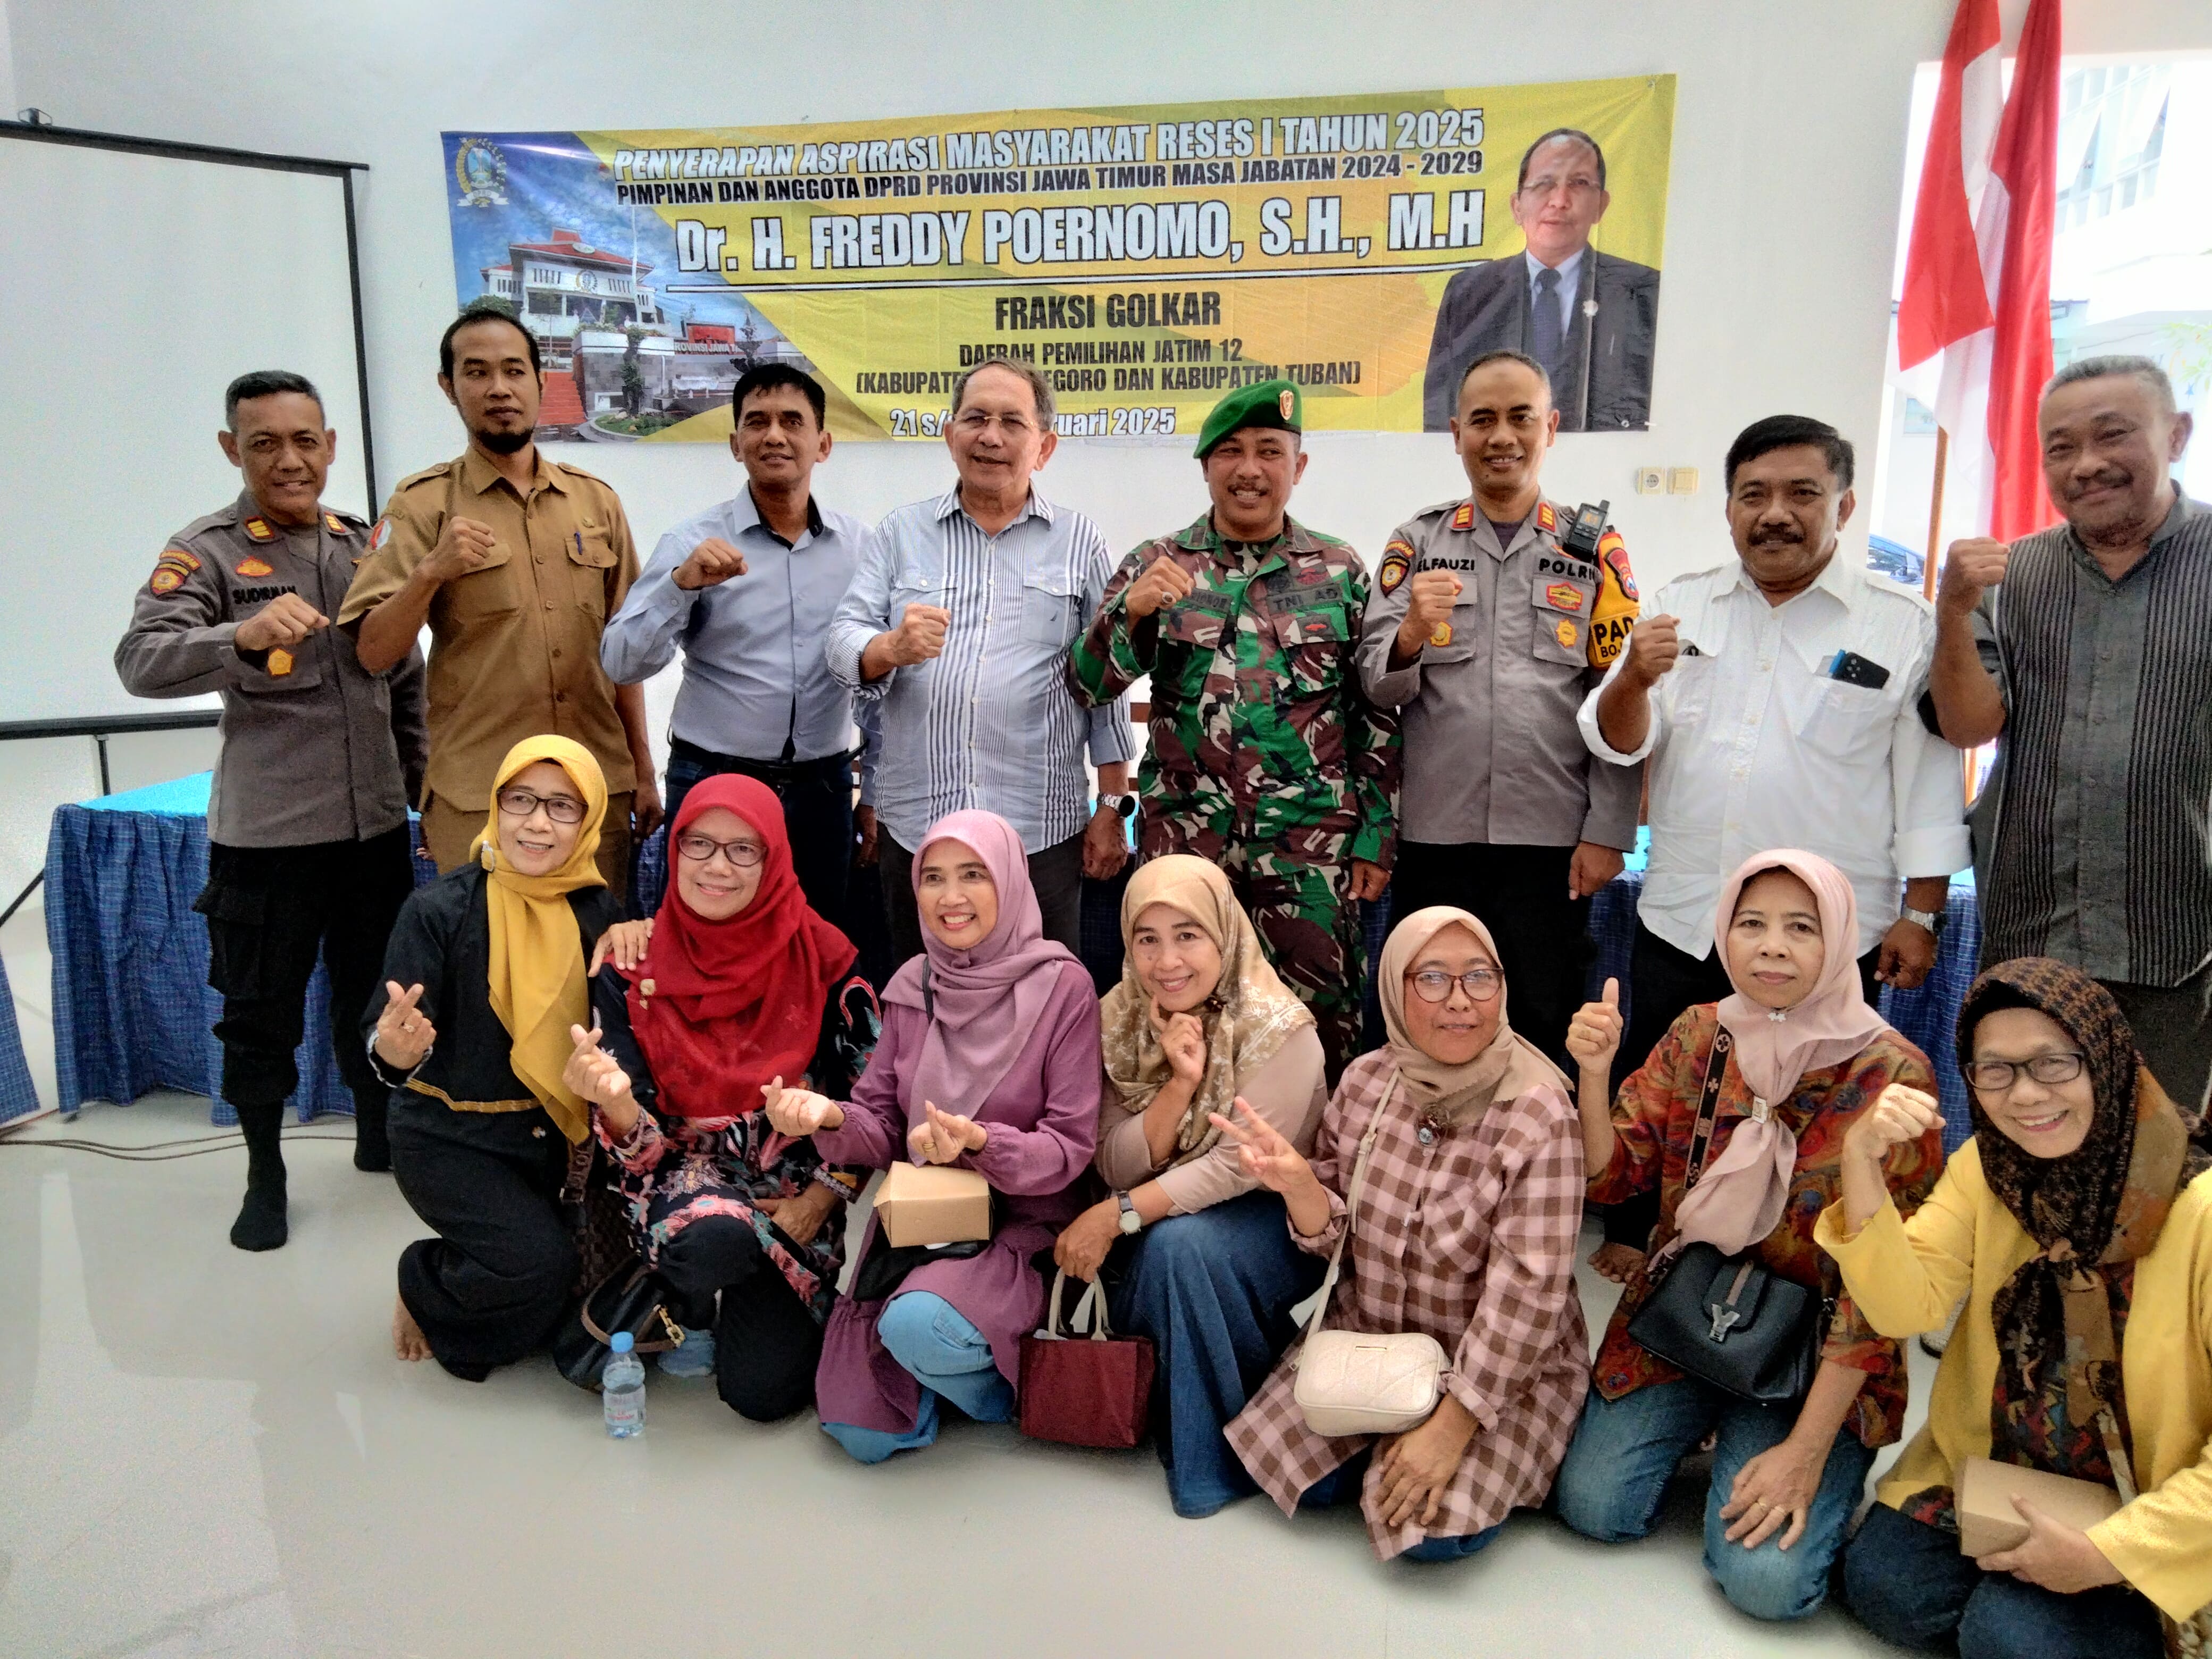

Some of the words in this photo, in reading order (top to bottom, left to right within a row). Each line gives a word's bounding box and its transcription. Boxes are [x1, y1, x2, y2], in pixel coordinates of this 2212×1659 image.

[614, 145, 794, 180] PENYERAPAN
[799, 137, 939, 173] ASPIRASI
[945, 125, 1150, 170] MASYARAKAT
[1157, 119, 1254, 160] RESES
[1260, 117, 1273, 156] I
[1280, 113, 1388, 152] TAHUN
[1395, 108, 1483, 150] 2025
[617, 180, 713, 205] PIMPINAN
[719, 179, 758, 203] DAN
[764, 176, 860, 200] ANGGOTA
[865, 174, 920, 198] DPRD
[927, 171, 1027, 195] PROVINSI
[1032, 167, 1090, 192] JAWA
[1095, 165, 1166, 189] TIMUR
[1172, 161, 1235, 186] MASA
[1241, 157, 1336, 182] JABATAN
[1342, 153, 1401, 178] 2024
[1421, 150, 1482, 175] 2029
[676, 219, 738, 272] Dr.
[751, 216, 797, 271] H.
[811, 211, 969, 266] FREDDY
[983, 200, 1244, 265] POERNOMO,
[1260, 196, 1371, 258] S.H.,
[1388, 189, 1485, 252] M.H
[995, 294, 1095, 331] FRAKSI
[1107, 292, 1221, 328] GOLKAR
[959, 343, 1035, 366] DAERAH
[1043, 339, 1145, 365] PEMILIHAN
[1153, 338, 1211, 363] JATIM
[1220, 338, 1243, 362] 12
[857, 372, 961, 393] (KABUPAT
[1115, 368, 1154, 391] DAN
[1161, 365, 1278, 390] KABUPATEN
[1285, 361, 1361, 386] TUBAN)
[890, 408, 918, 437] 21
[920, 409, 954, 437] s/
[1112, 407, 1176, 435] 2025
[1539, 558, 1595, 580] POLRI
[1273, 594, 1303, 612] TNI
[1316, 588, 1338, 601] AD
